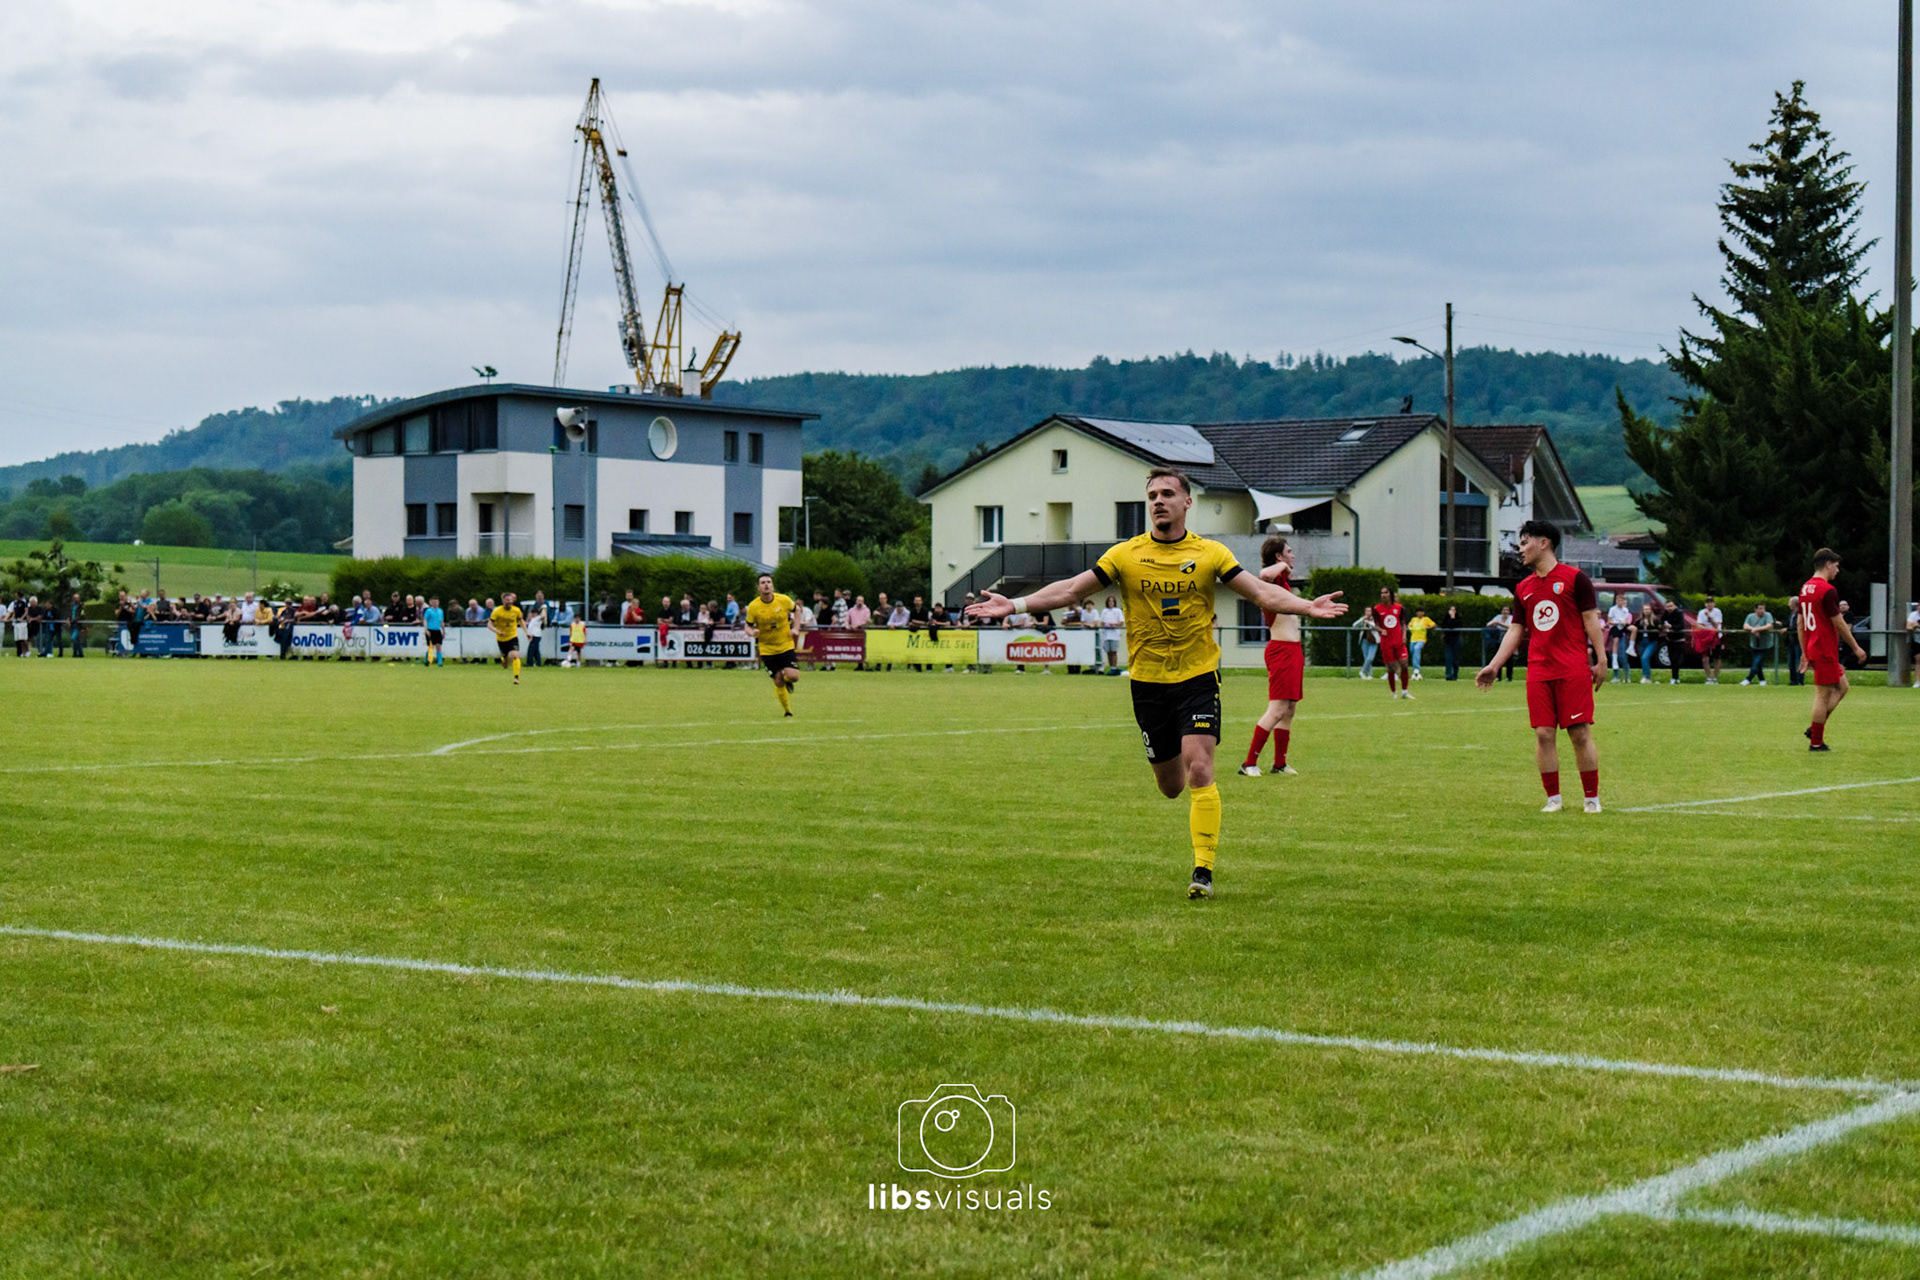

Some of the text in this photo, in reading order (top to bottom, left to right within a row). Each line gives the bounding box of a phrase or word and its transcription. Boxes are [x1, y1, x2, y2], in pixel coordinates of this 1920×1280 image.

[1141, 580, 1198, 593] PADEA
[1801, 602, 1816, 631] 16
[388, 632, 419, 646] BWT
[686, 644, 749, 655] 026 422 19 18
[1009, 646, 1064, 658] MICARNA
